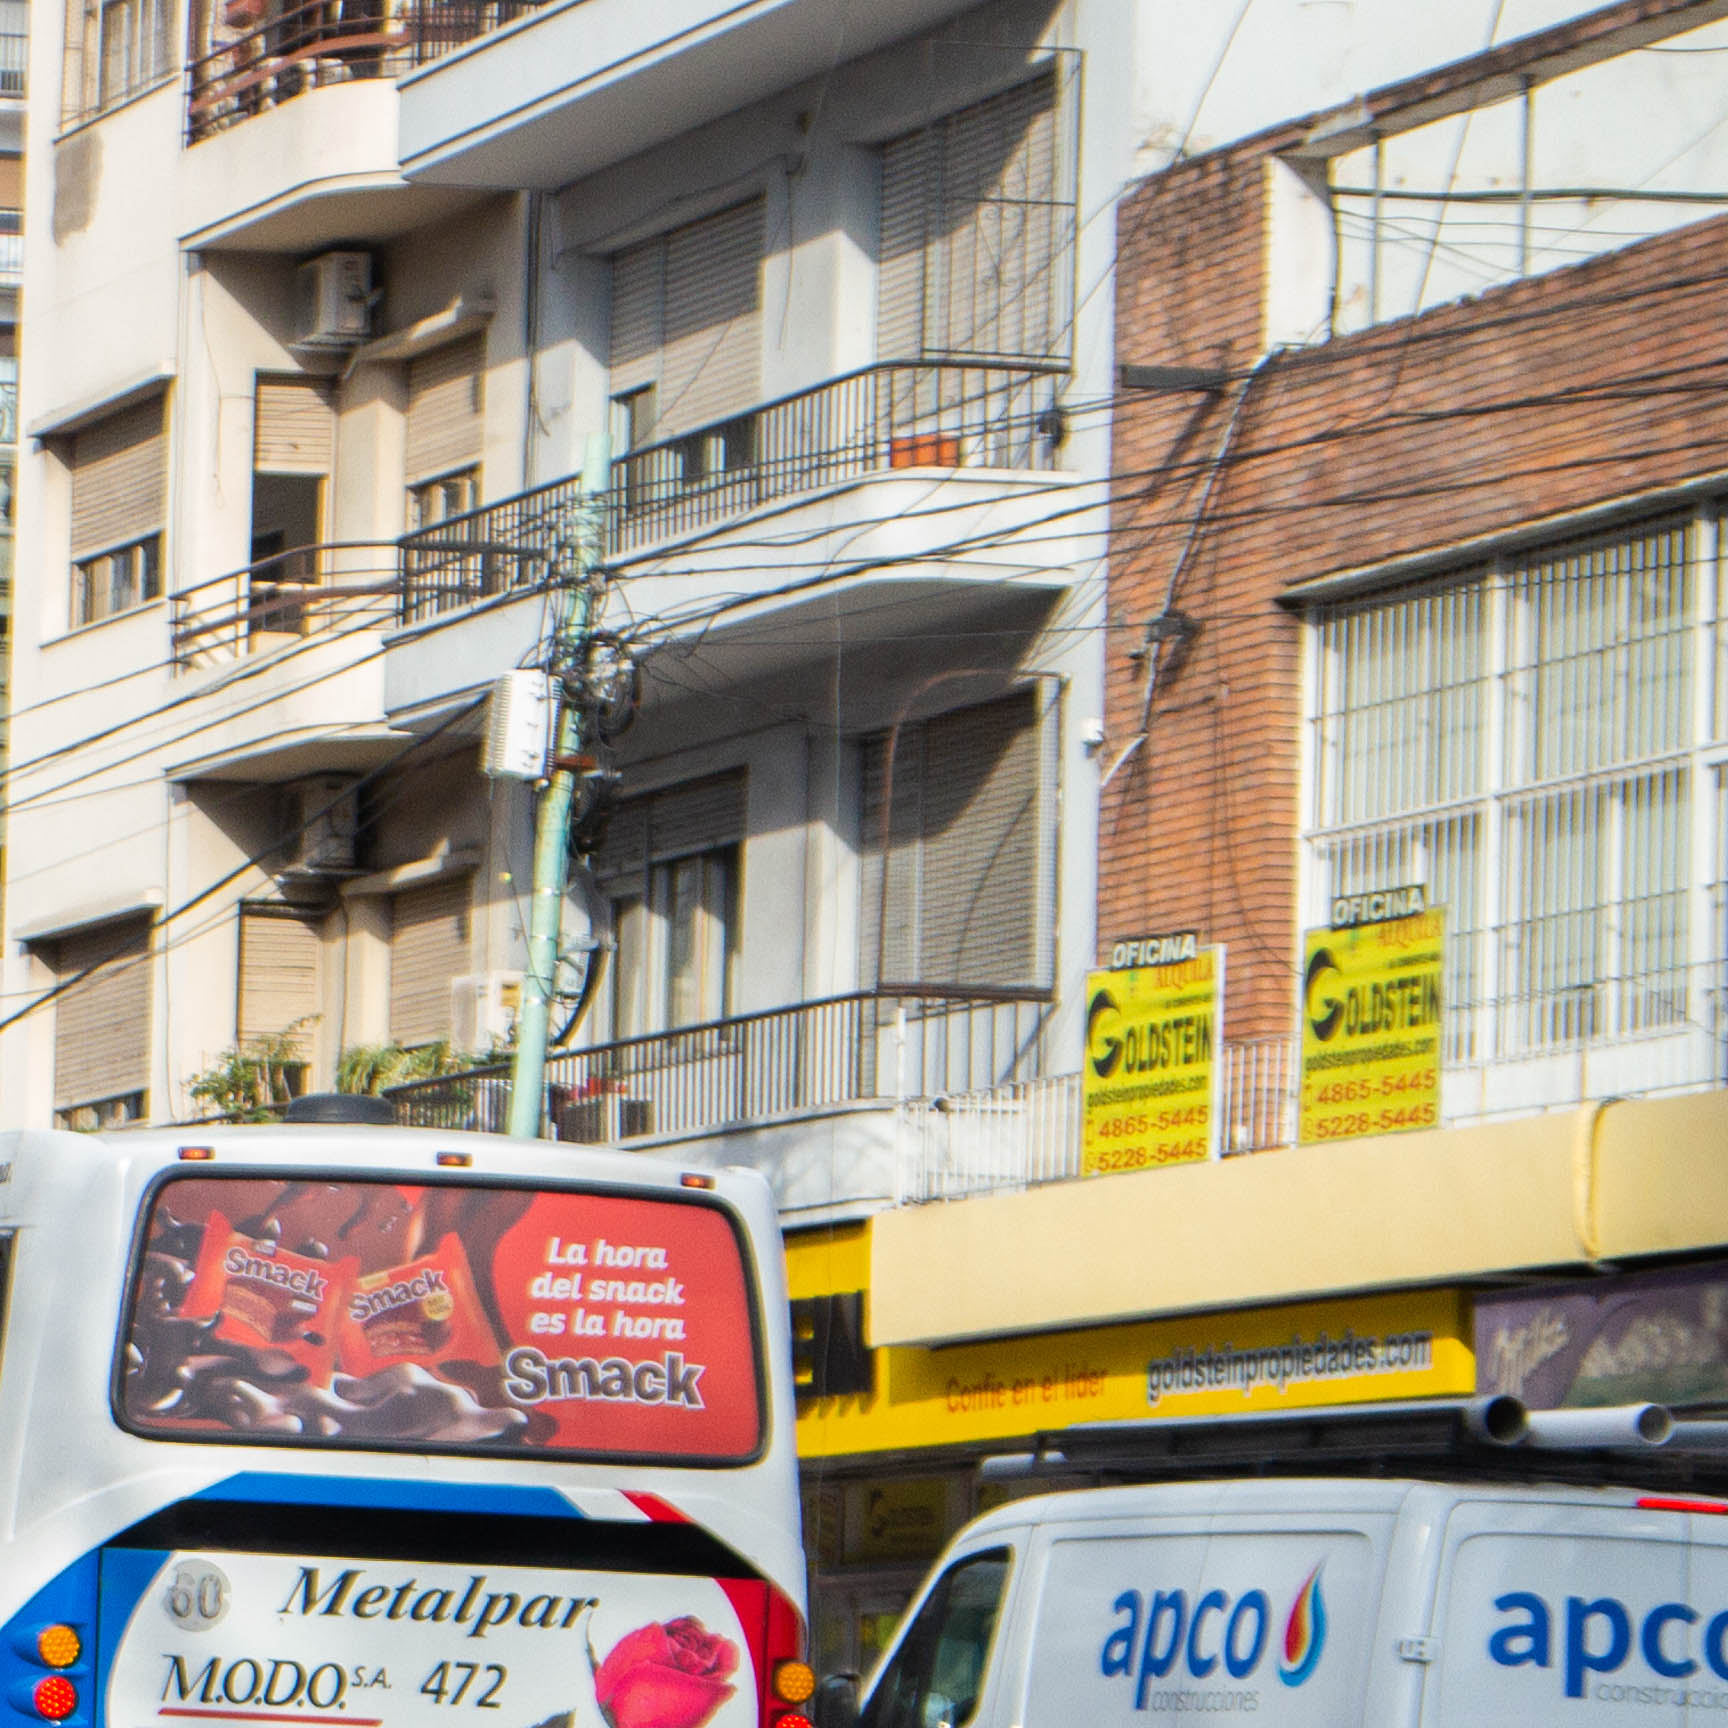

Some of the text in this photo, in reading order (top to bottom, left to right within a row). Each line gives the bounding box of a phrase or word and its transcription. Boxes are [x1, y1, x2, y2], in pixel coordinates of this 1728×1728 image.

[1333, 888, 1425, 925] OFICINA
[1113, 935, 1197, 968] OFICINA
[1306, 947, 1441, 1042] GOLDSTEIN
[1087, 988, 1212, 1078] GOLDSTEIN
[1317, 1069, 1437, 1104] 4865-5445
[1099, 1105, 1209, 1138] 4865-5445
[1316, 1103, 1436, 1138] 5228-5445
[1097, 1138, 1208, 1172] 5228-5445
[548, 1237, 669, 1269] La hora
[225, 1246, 328, 1302] Smack
[530, 1272, 686, 1304] del snack
[348, 1268, 448, 1321] Smack
[529, 1308, 687, 1339] es la hora
[504, 1346, 706, 1410] Smack
[1013, 1377, 1036, 1405] en
[1041, 1364, 1058, 1402] el
[1147, 1328, 1433, 1407] goldsteinpropiedades.com
[278, 1567, 600, 1638] Metalpar
[1100, 1588, 1272, 1711] apco
[160, 1652, 508, 1710] M.O.D.O. S.A. 472
[1151, 1690, 1260, 1712] construcciones
